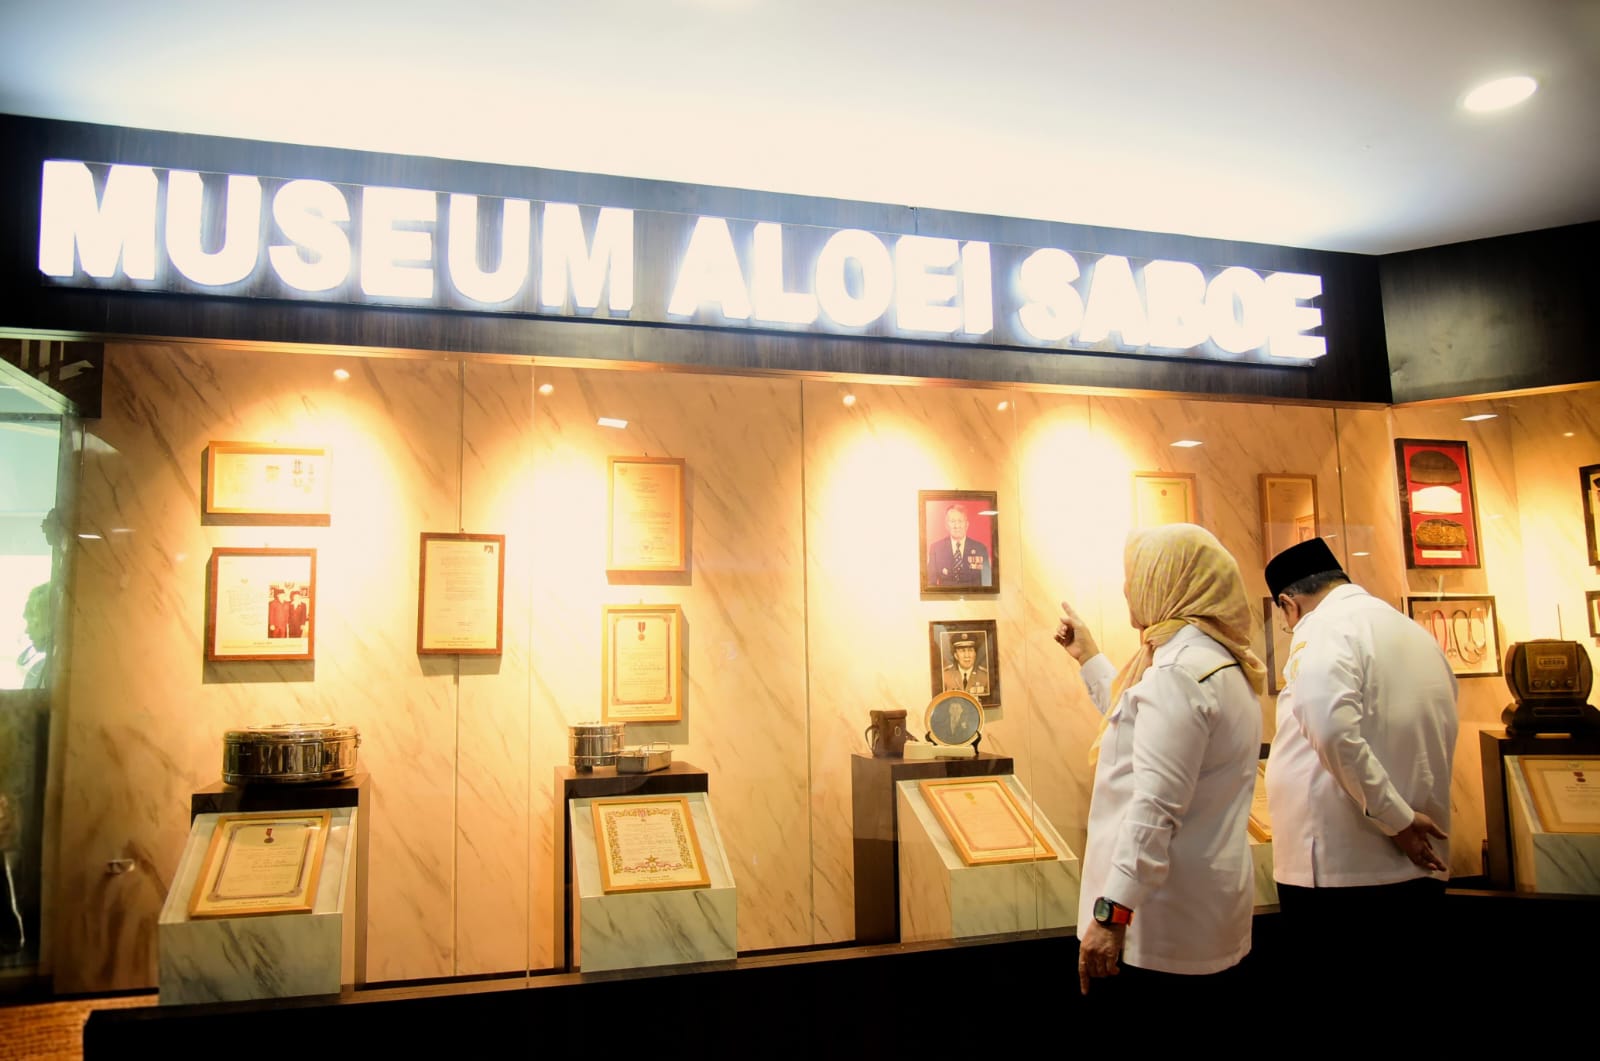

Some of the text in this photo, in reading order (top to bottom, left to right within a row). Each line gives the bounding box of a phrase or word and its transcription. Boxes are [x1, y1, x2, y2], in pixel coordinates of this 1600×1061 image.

[38, 160, 1327, 364] MUSEUM ALOEI SABOE
